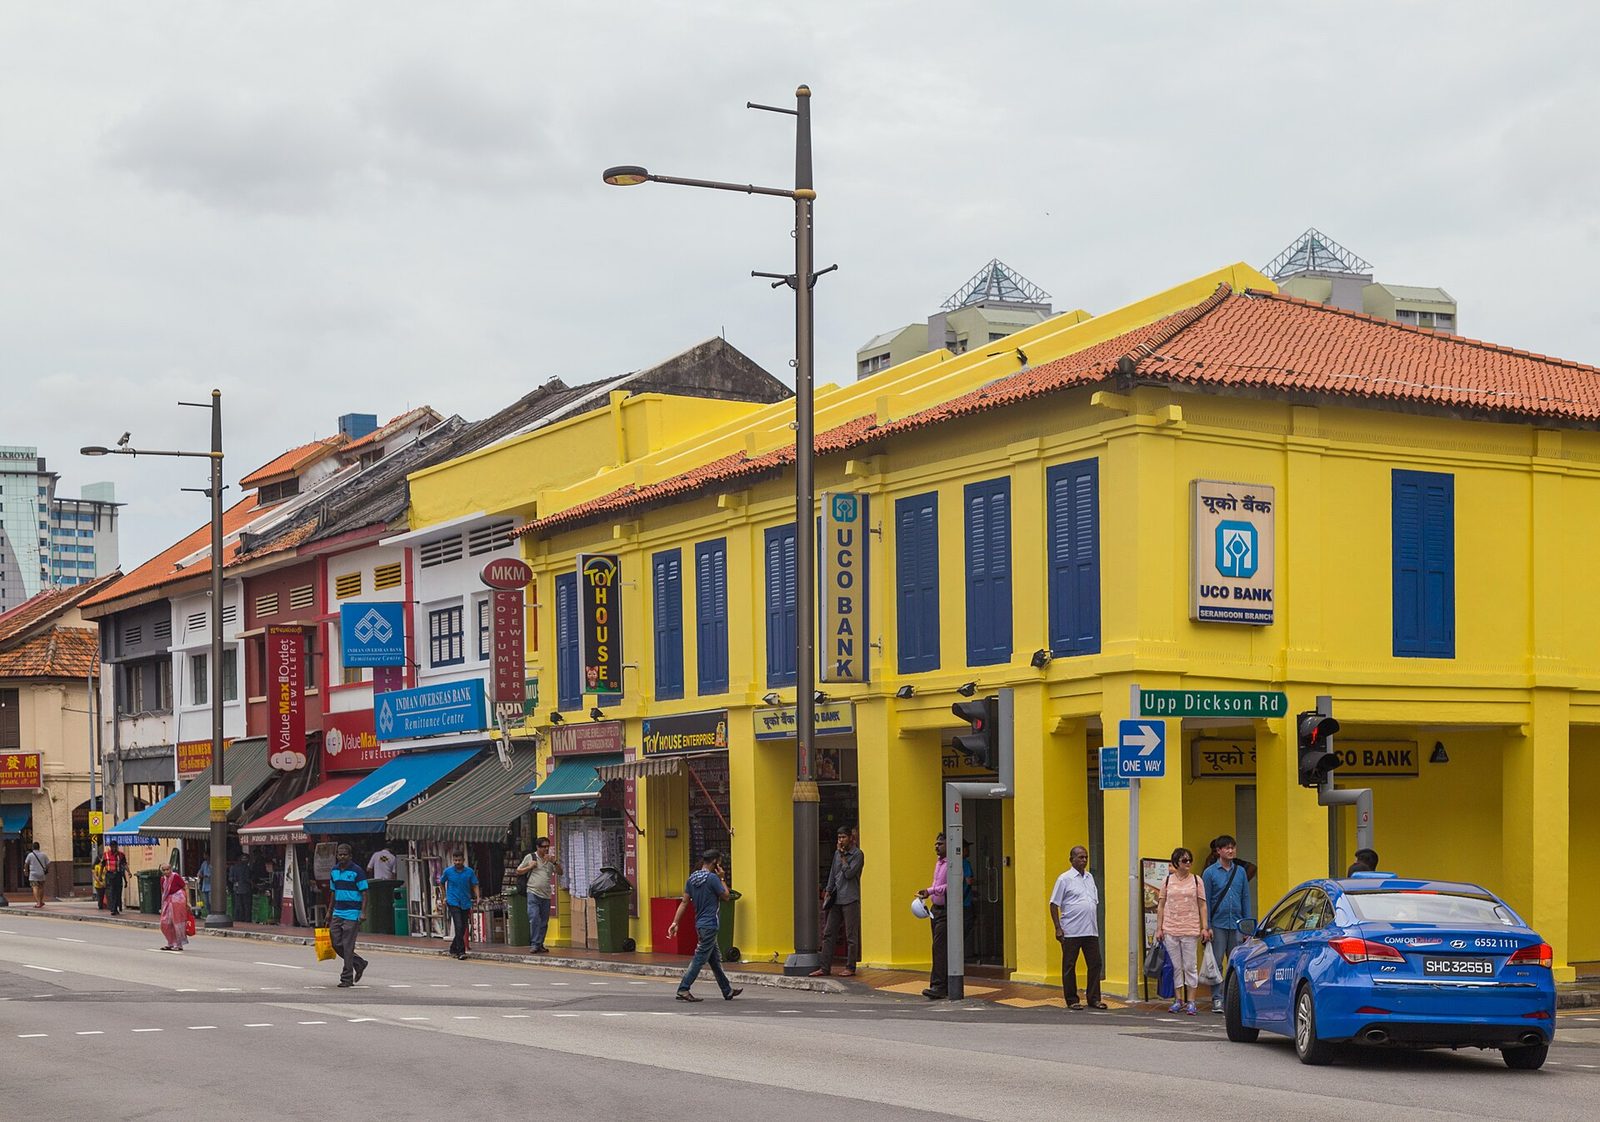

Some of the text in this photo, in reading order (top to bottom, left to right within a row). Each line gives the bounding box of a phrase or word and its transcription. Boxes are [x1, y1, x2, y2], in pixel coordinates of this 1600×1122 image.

[0, 452, 36, 460] KROYAL
[1201, 494, 1271, 514] यूको बैंक
[492, 565, 525, 580] MKM
[584, 566, 617, 587] TOY
[836, 528, 853, 677] UCO BANK
[1200, 584, 1272, 602] UCO BANK
[1200, 609, 1274, 621] SERANGOON BRANCH
[497, 593, 509, 675] COSTUME
[595, 588, 609, 680] HOUSE
[278, 639, 289, 675] Outlet
[509, 607, 521, 698] JEWELLERY
[289, 640, 297, 714] JEWELLERY
[395, 687, 471, 711] INDIAN OVERSEAS BANK
[1145, 692, 1279, 713] Upp Dickson Rd
[280, 684, 290, 749] ValueMax
[405, 713, 464, 730] Remittance Centre
[821, 711, 840, 722] BANK
[343, 732, 377, 750] ValueMax
[552, 729, 577, 752] MKM
[643, 731, 715, 753] TOY HOUSE ENTERPRISE
[1122, 760, 1162, 772] ONE WAY
[1203, 745, 1245, 771] यूको
[1337, 749, 1412, 766] CO BANK
[954, 802, 960, 813] 6
[1474, 938, 1519, 948] 6552 1111
